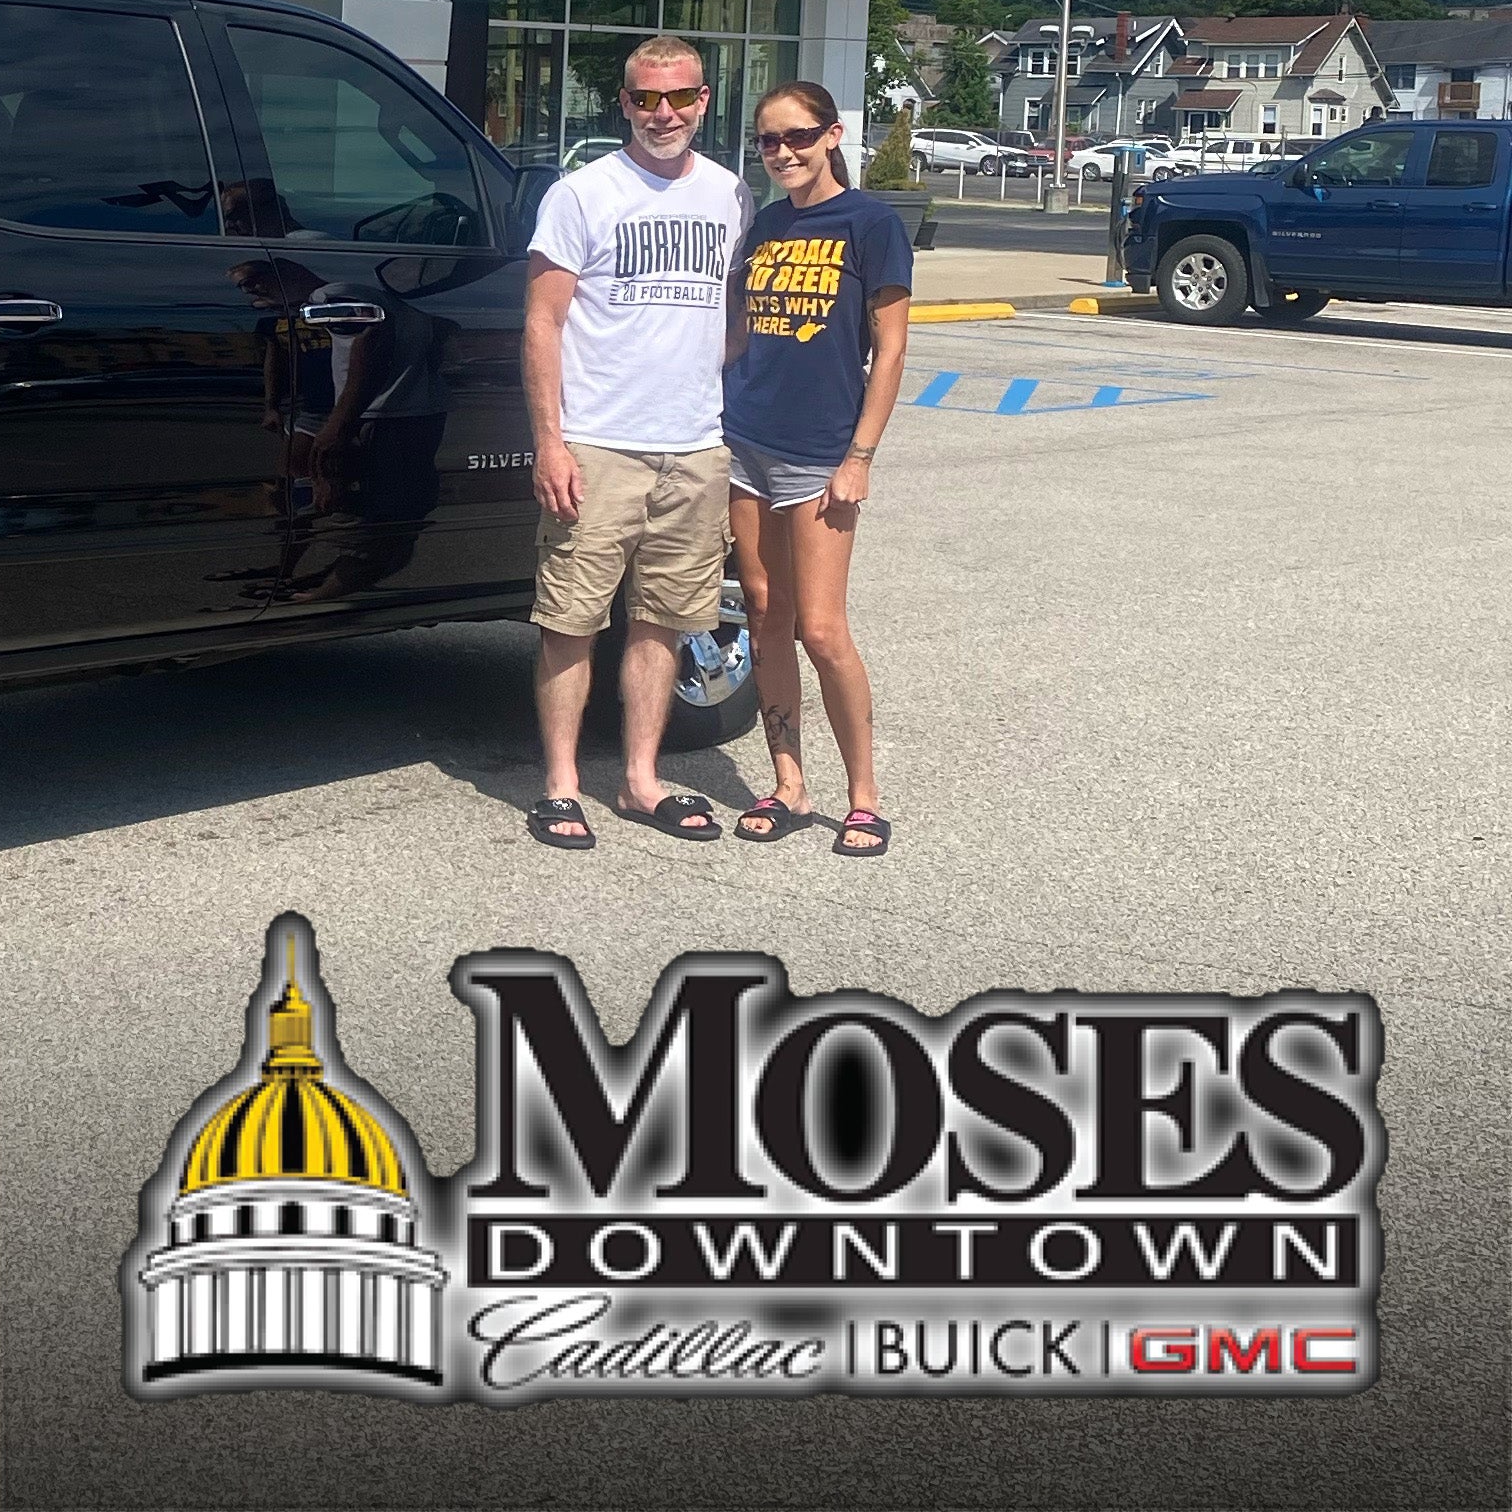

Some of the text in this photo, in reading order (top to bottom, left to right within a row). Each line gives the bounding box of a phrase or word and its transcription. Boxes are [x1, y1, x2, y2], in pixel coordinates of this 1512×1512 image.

[614, 220, 727, 281] WARRIORS
[640, 285, 705, 301] FOOTBALL
[772, 266, 841, 295] BEER
[785, 296, 836, 317] WHY
